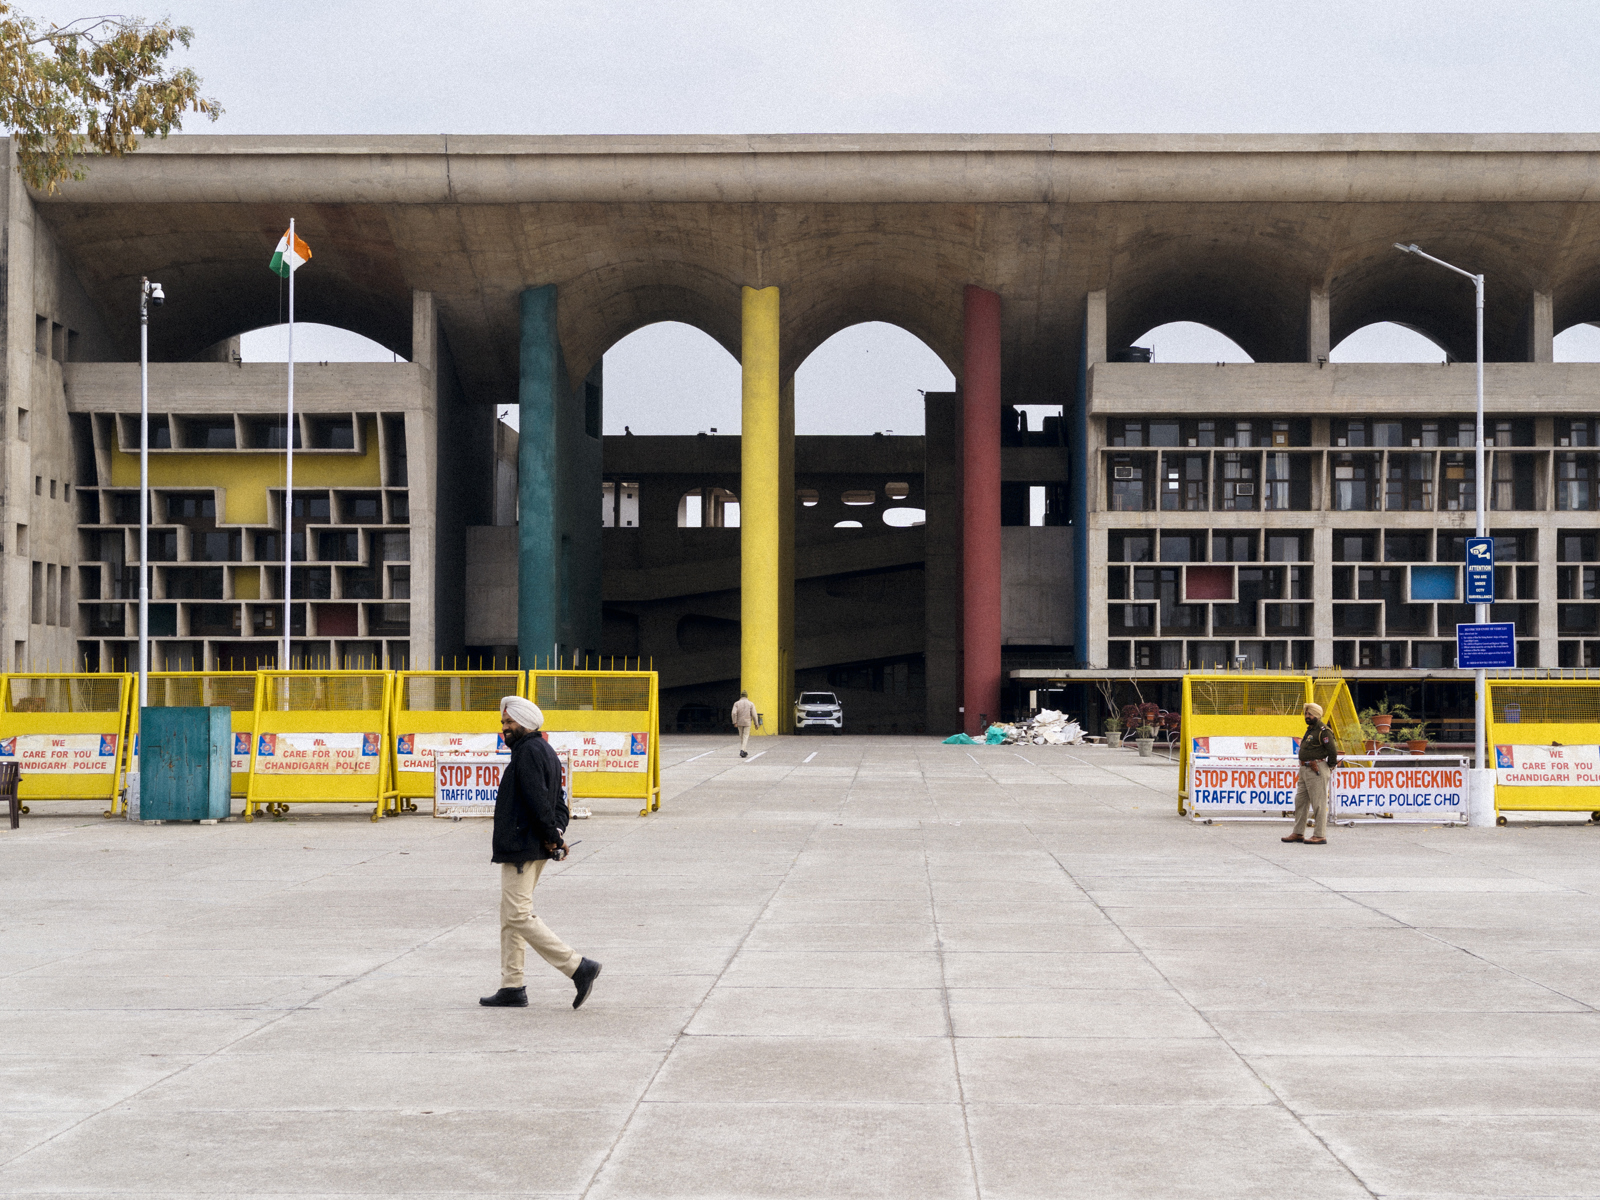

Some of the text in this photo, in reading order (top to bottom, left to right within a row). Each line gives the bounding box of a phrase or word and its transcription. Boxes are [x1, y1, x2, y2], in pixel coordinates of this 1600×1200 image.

[440, 765, 500, 786] STOP FOR
[1195, 770, 1299, 788] STOP FOR CHECK
[1368, 771, 1394, 788] FOR
[1396, 770, 1462, 788] CHECKING
[441, 789, 498, 800] TRAFFIC POLIC
[1195, 790, 1293, 804] TRAFFIC POLICE
[1389, 794, 1431, 806] POLICE
[1434, 794, 1460, 806] CHD
